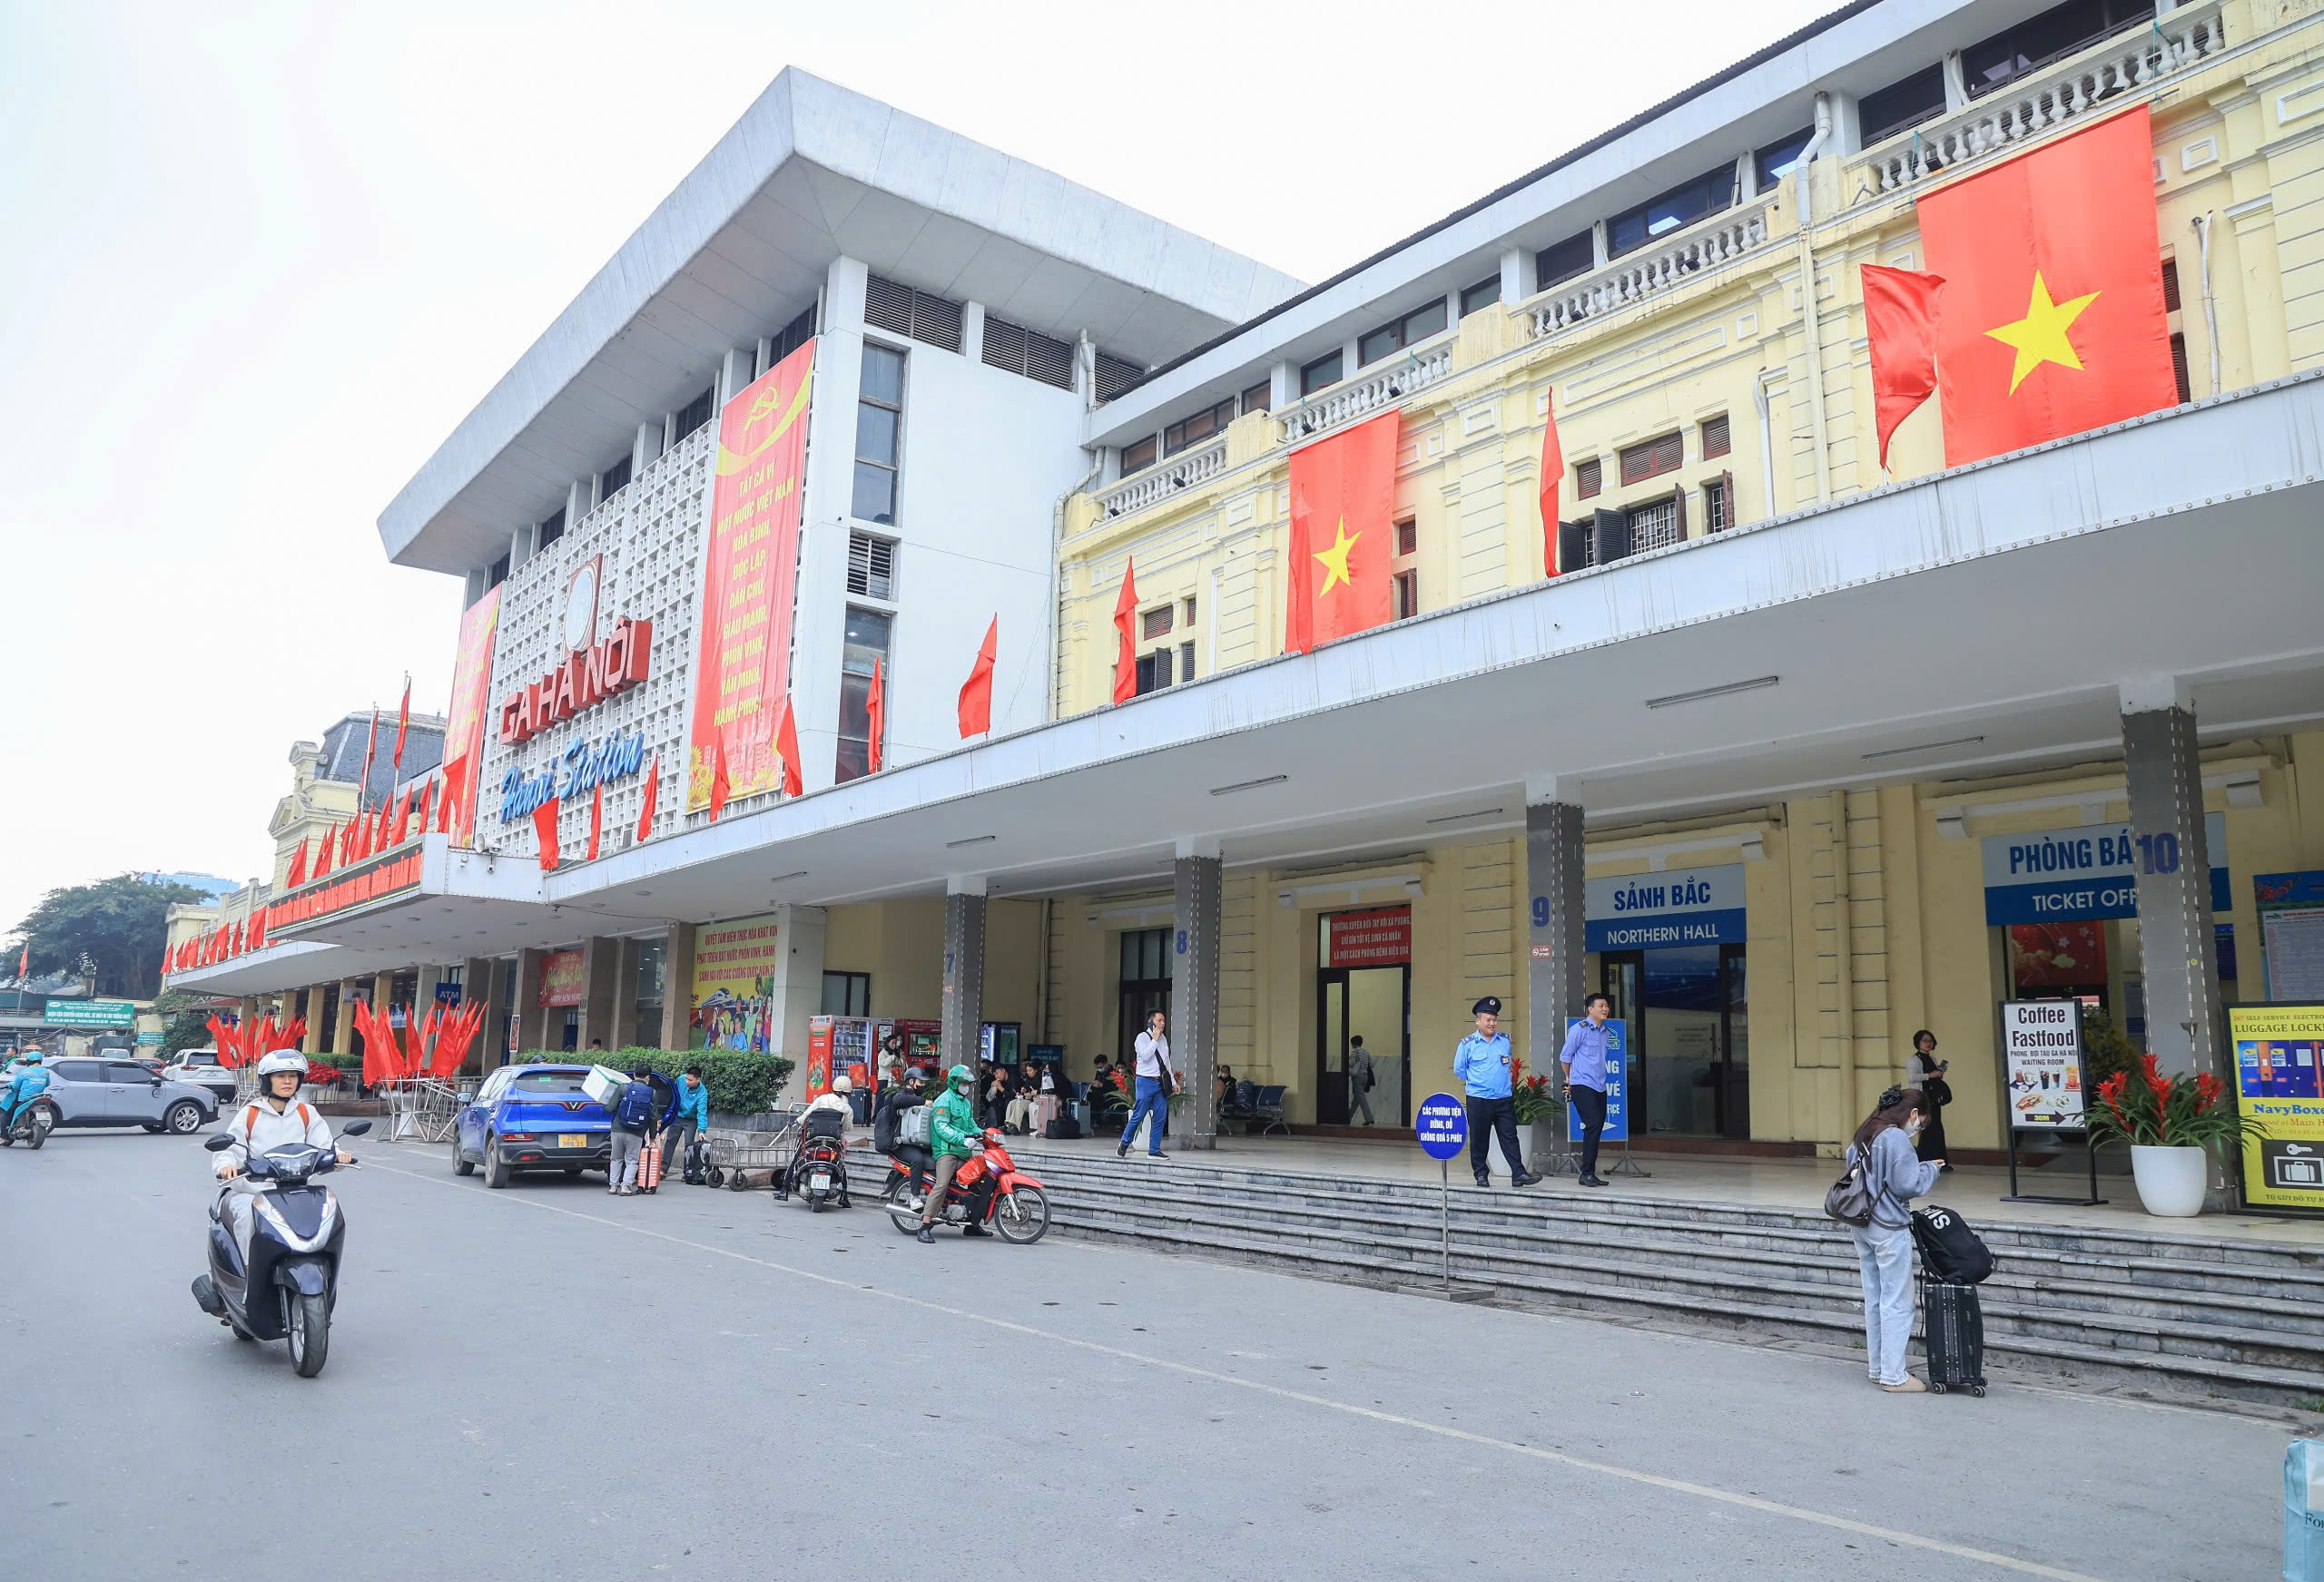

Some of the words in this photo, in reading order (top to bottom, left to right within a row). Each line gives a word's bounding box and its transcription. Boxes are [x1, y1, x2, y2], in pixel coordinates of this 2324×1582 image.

[558, 727, 645, 801] Station
[2010, 836, 2093, 874] PHÒNG
[2135, 832, 2179, 874] 10
[1614, 881, 1665, 911] SẢNH
[1671, 876, 1711, 906] BẮC
[2033, 890, 2094, 911] TICKET
[1532, 896, 1549, 927] 9
[1176, 929, 1187, 955] 8
[1608, 927, 1679, 945] NORTHERN
[1684, 924, 1718, 940] HALL
[947, 953, 954, 973] 7
[439, 990, 459, 999] ATM
[2018, 1007, 2065, 1024] Coffee
[2012, 1029, 2075, 1047] Fastfood
[2235, 1024, 2288, 1033] LUGGAGE
[2290, 1023, 2324, 1032] LOCK
[1606, 1080, 1620, 1096] VÉ
[1422, 1105, 1432, 1115] CÁC
[2290, 1117, 2315, 1126] Main
[1420, 1131, 1435, 1142] KHÔNG
[1446, 1134, 1450, 1142] 5
